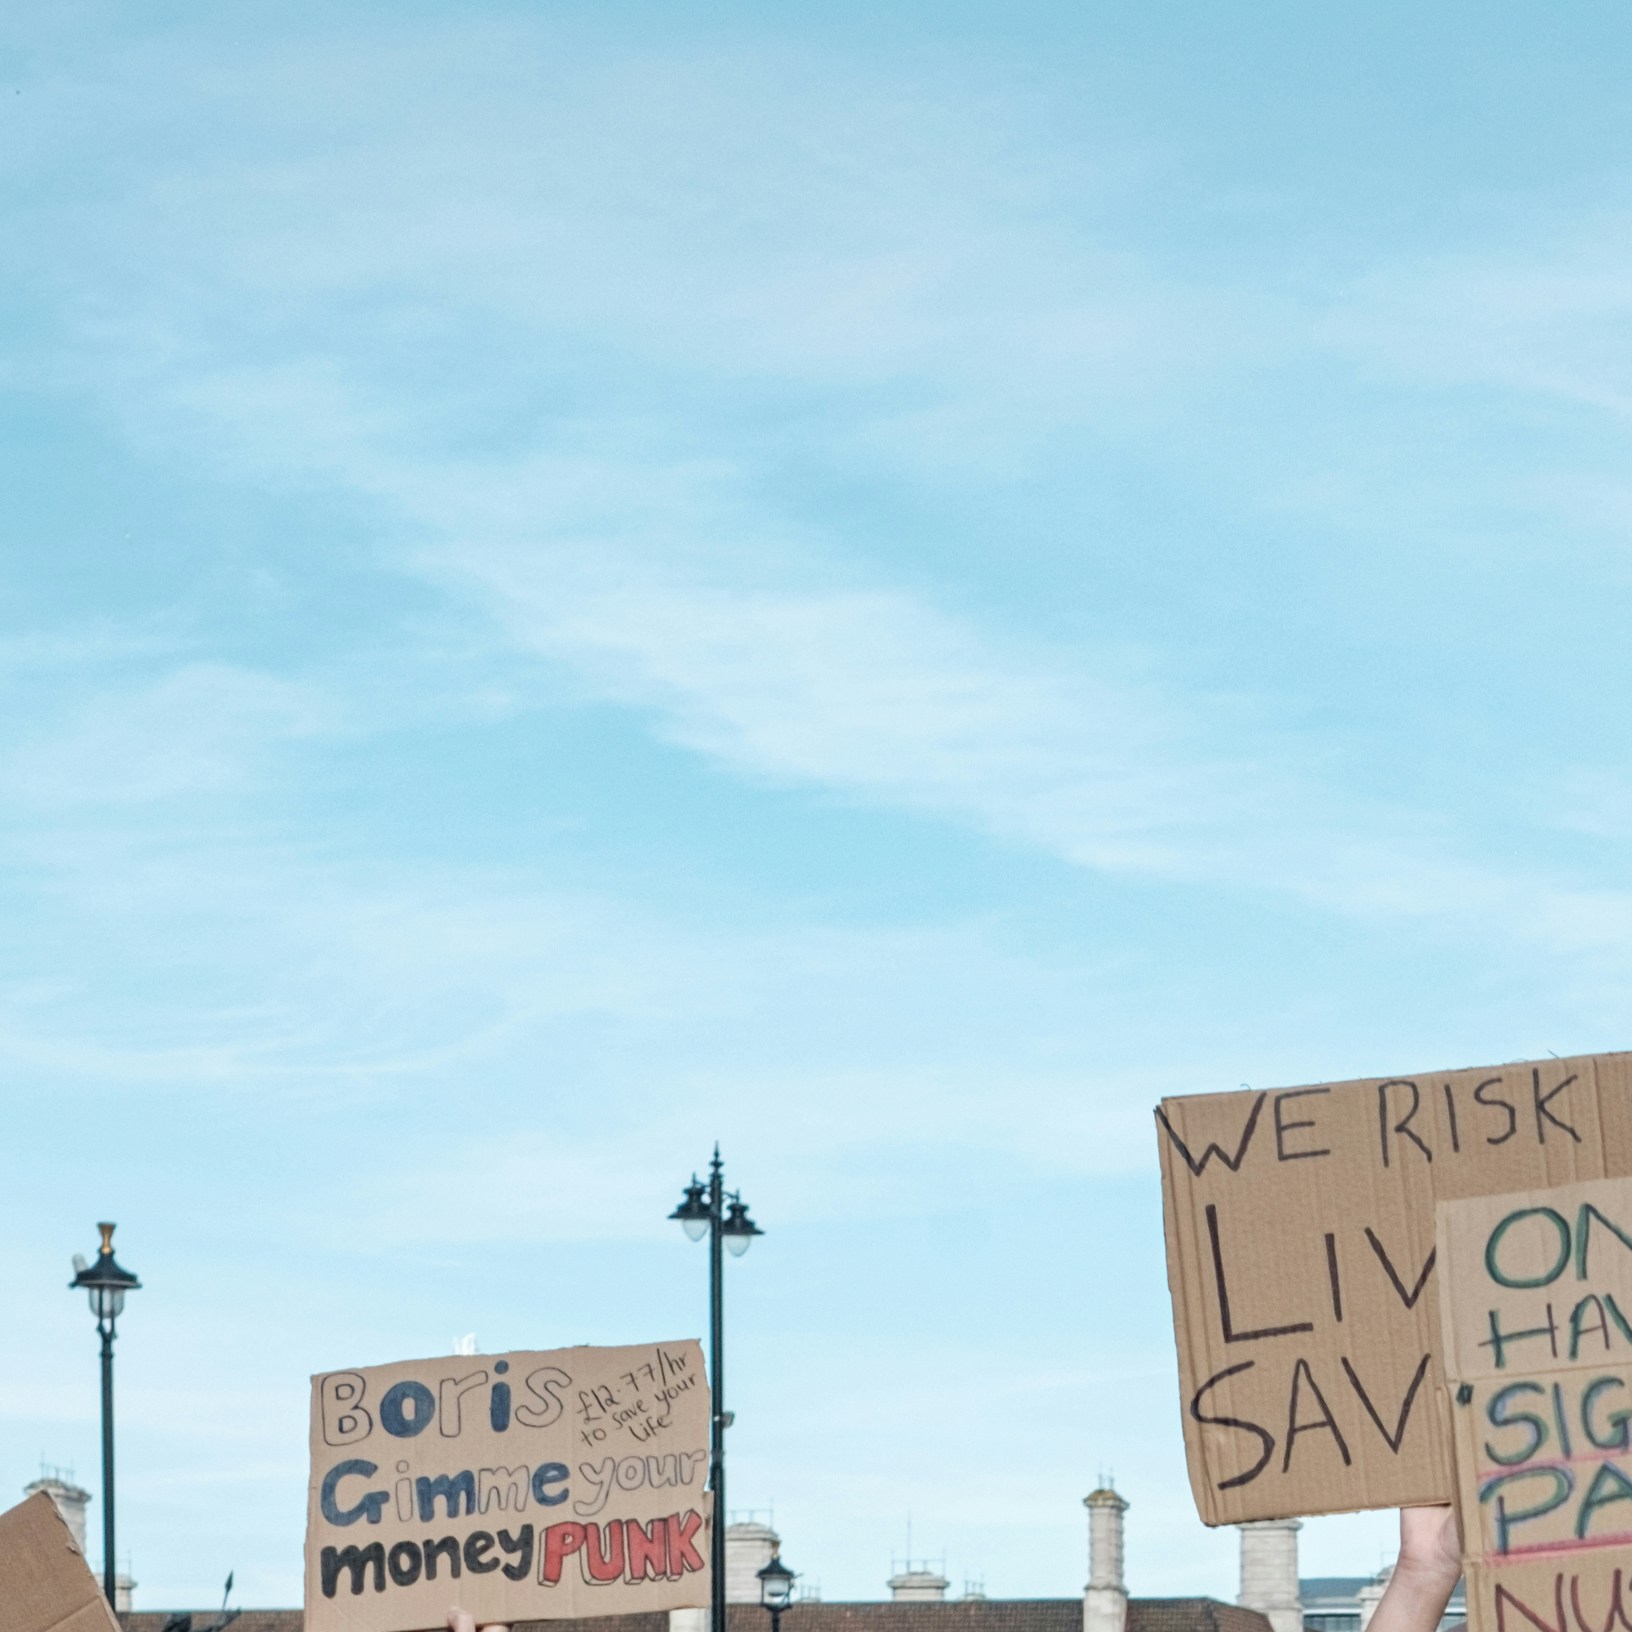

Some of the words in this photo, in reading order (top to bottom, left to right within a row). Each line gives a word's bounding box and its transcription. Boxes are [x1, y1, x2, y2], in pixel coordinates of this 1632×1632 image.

[1156, 1085, 1331, 1177] WE
[1380, 1068, 1581, 1167] RISK
[1204, 1204, 1435, 1342] LIV
[580, 1427, 607, 1447] to
[612, 1398, 648, 1430] save
[654, 1373, 697, 1416] your
[1190, 1352, 1431, 1491] SAV
[320, 1458, 570, 1527] Gimme
[573, 1449, 707, 1516] your
[320, 1522, 534, 1599] money
[537, 1508, 706, 1588] PUNK
